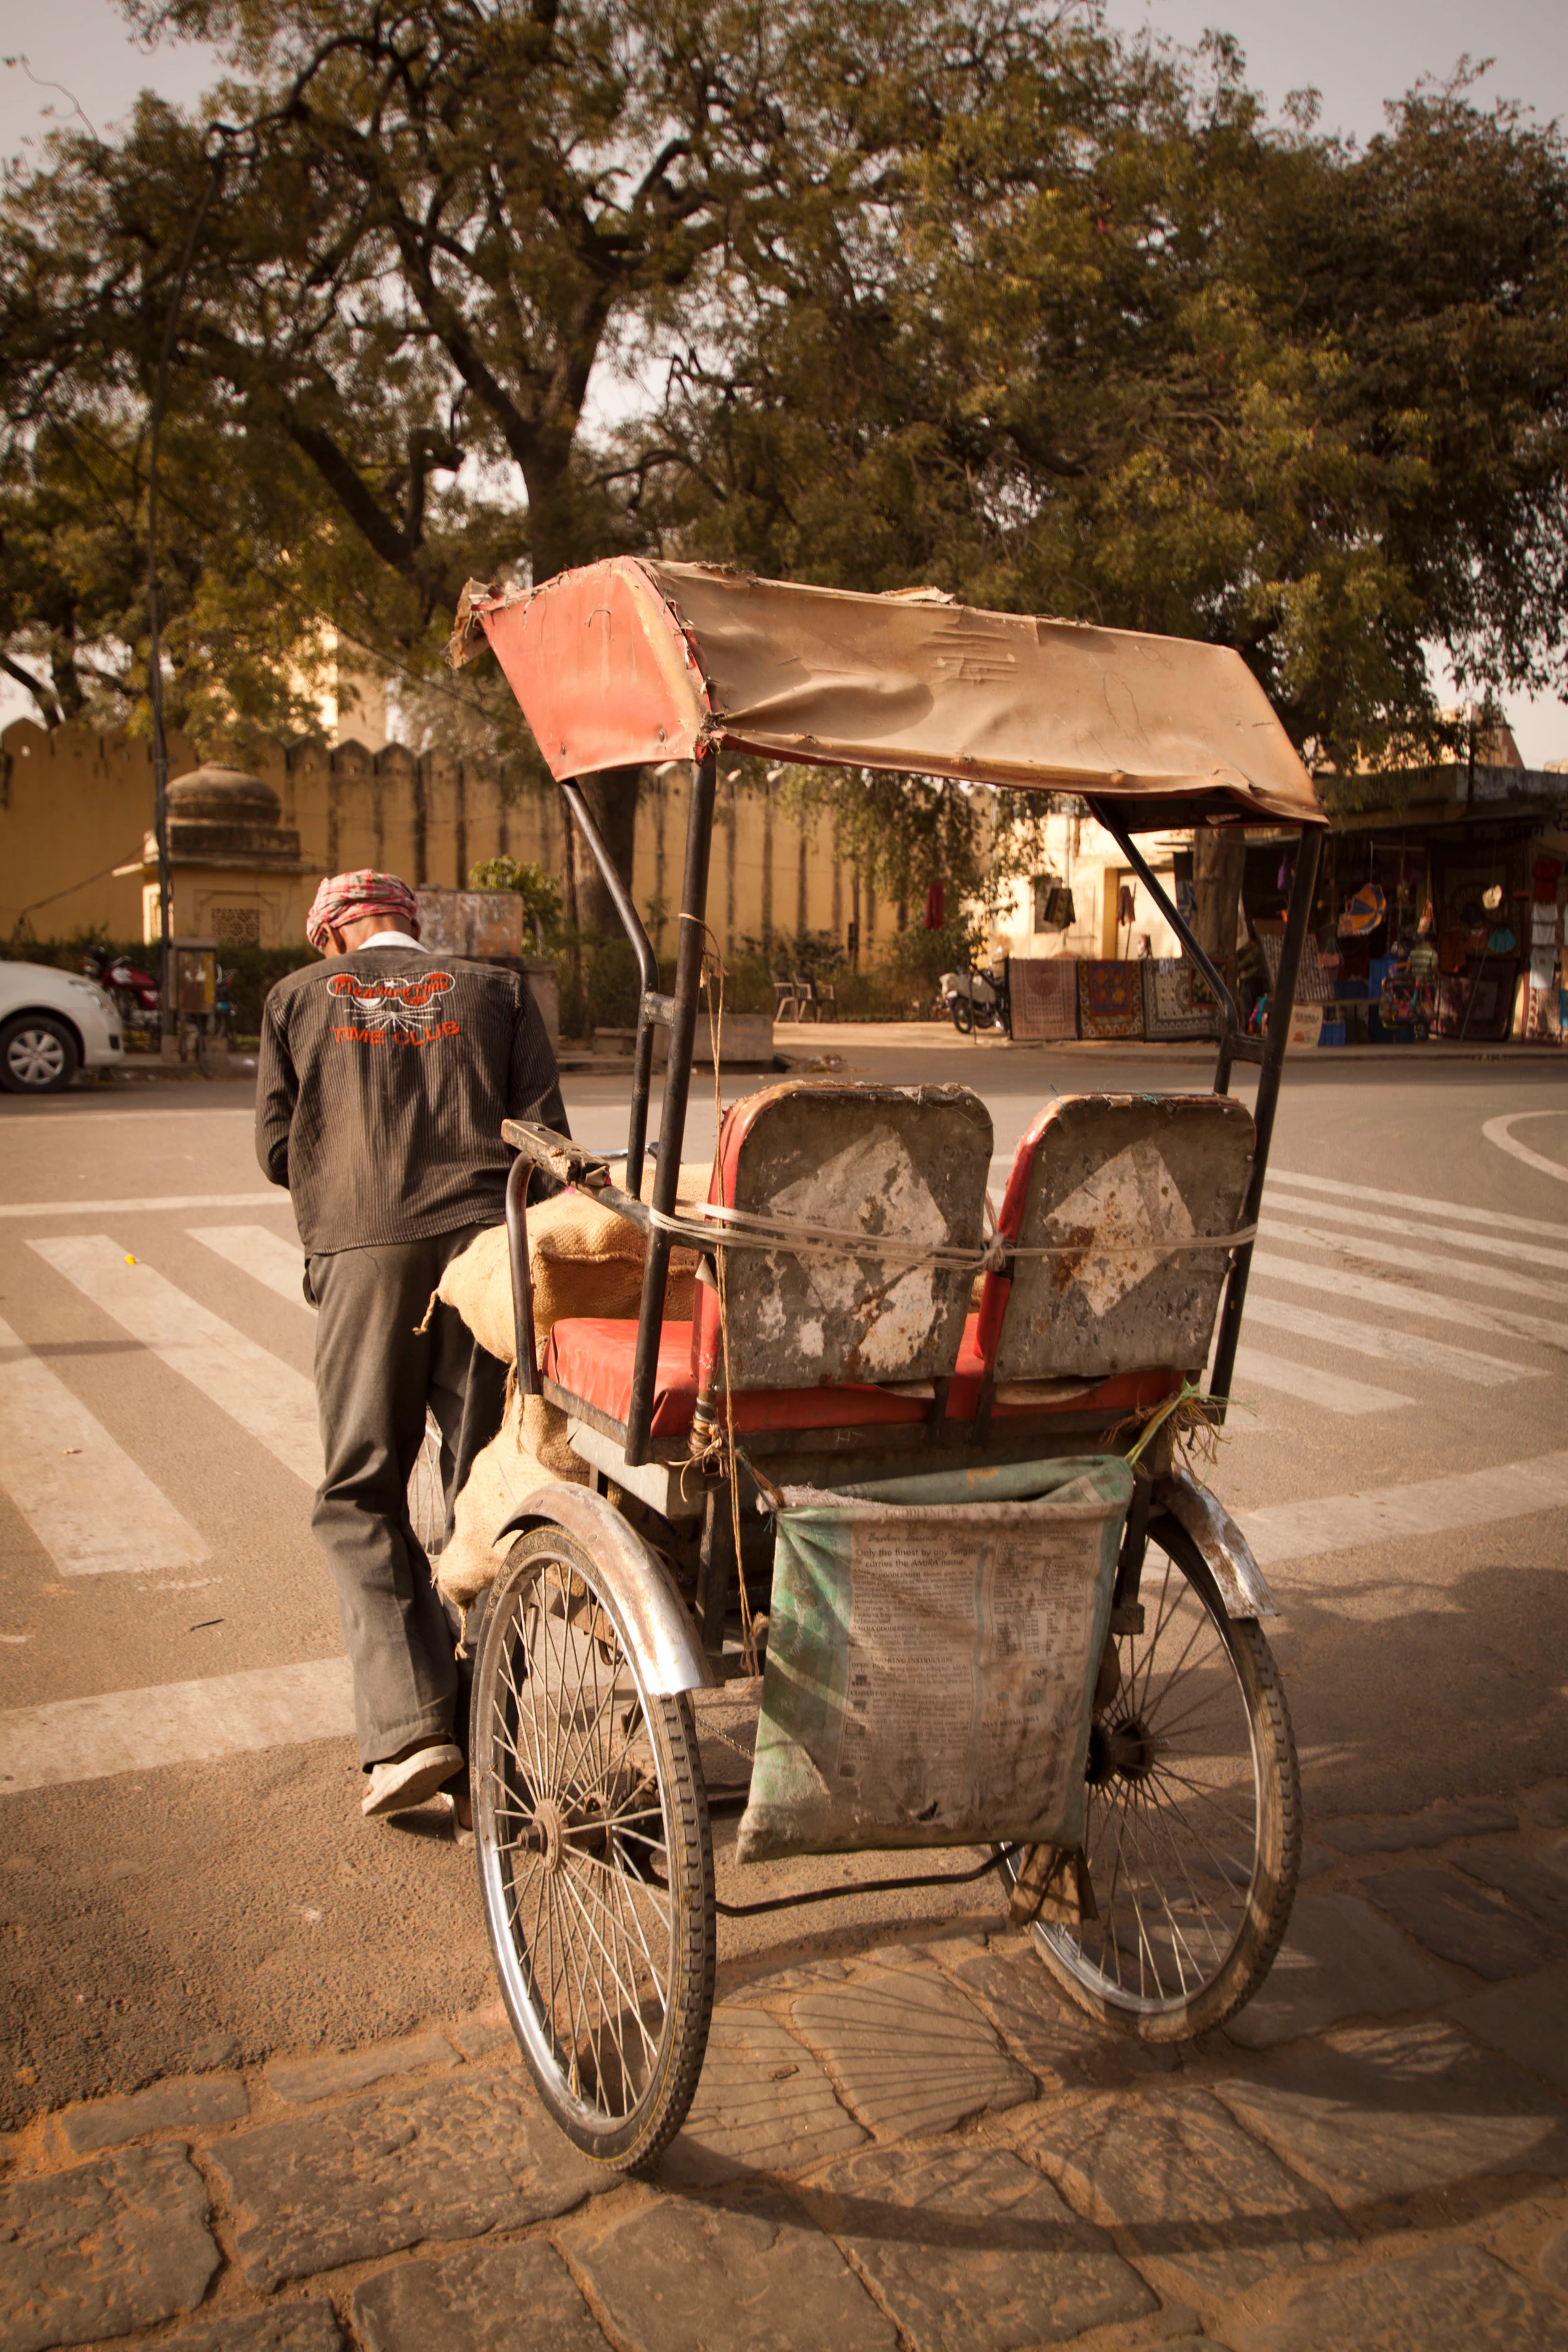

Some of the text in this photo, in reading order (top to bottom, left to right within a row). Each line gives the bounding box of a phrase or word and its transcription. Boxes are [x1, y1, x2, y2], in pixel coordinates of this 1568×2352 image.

[334, 981, 449, 998] Pleasure Time
[332, 1020, 460, 1046] TIME CLUB
[856, 1546, 976, 1558] Only the finest by any length
[865, 1559, 892, 1568] carries
[895, 1558, 908, 1567] the
[911, 1558, 939, 1567] AMIRA
